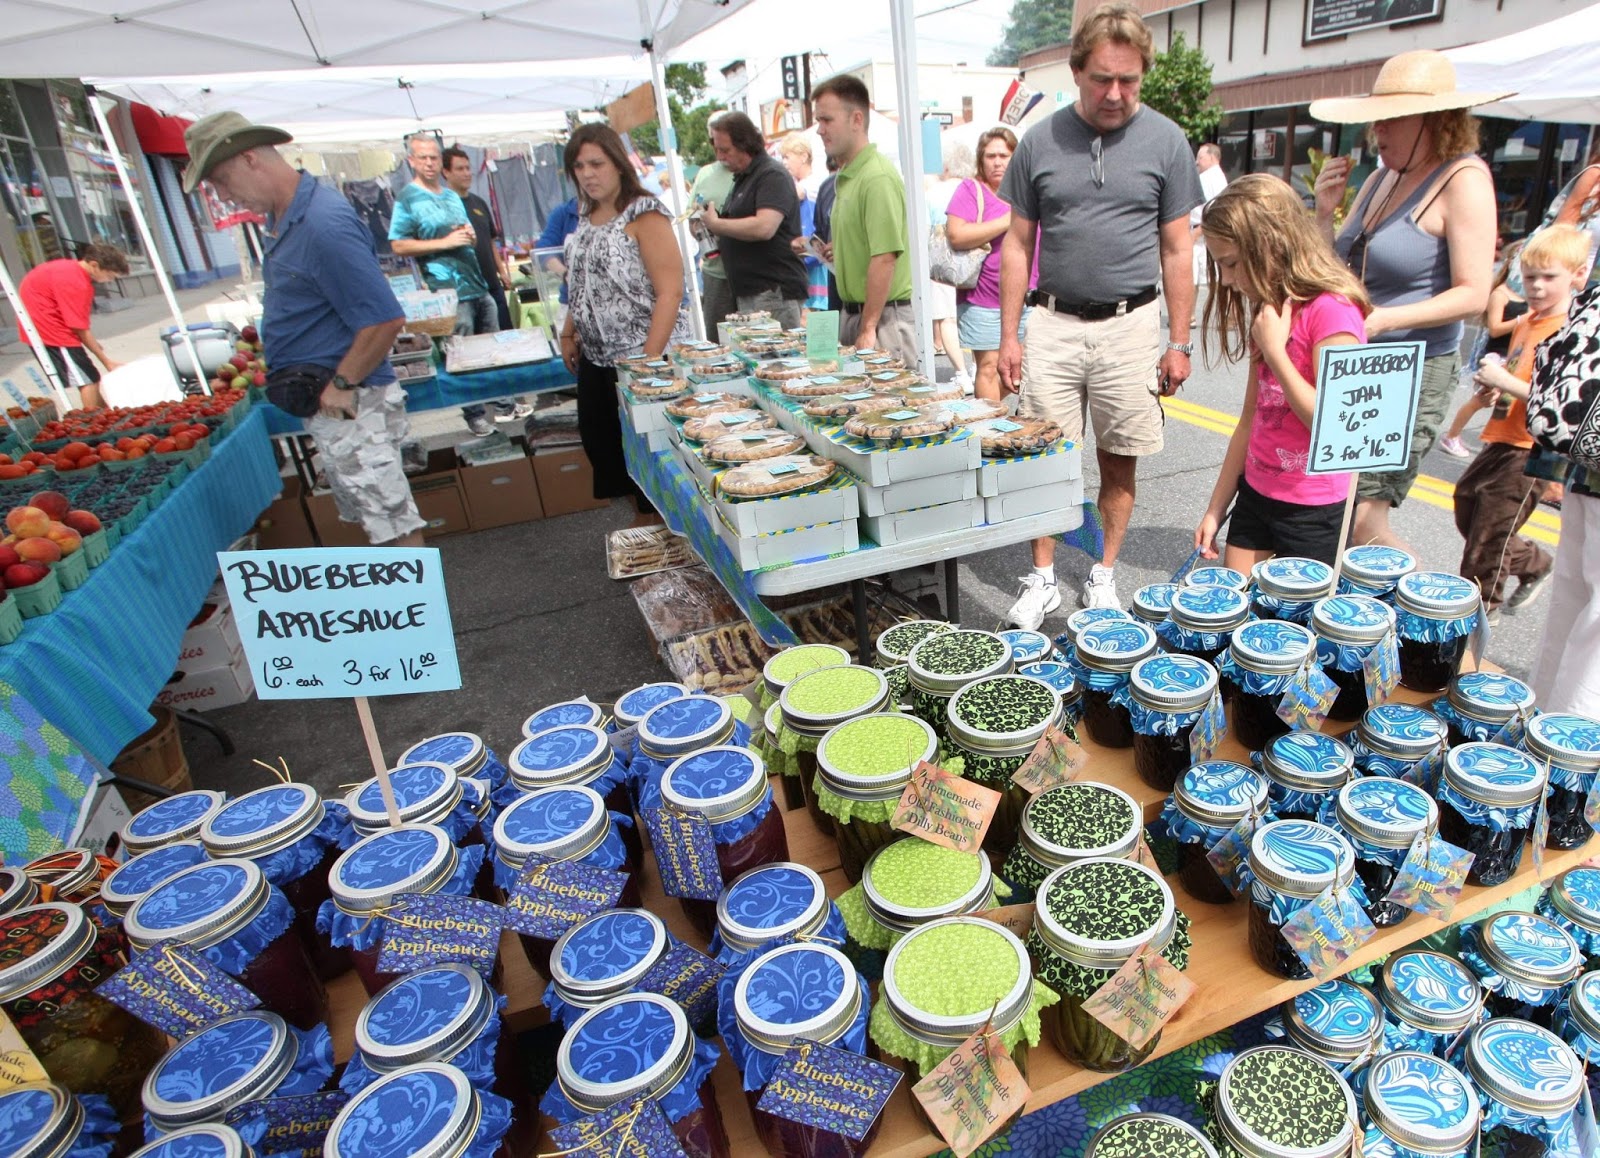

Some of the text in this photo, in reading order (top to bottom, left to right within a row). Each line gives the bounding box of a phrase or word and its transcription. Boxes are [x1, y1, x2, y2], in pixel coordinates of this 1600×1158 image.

[1330, 353, 1416, 380] BLUEBERRY
[1341, 384, 1382, 406] JAM
[1320, 445, 1334, 462] 3
[1340, 445, 1365, 461] for
[227, 559, 424, 602] BLUEBERRY
[257, 603, 426, 642] APPLESAUCE
[296, 675, 324, 687] each
[343, 660, 362, 685] 3
[369, 665, 391, 682] for
[1294, 698, 1311, 717] Jam
[921, 777, 983, 811] Homemade
[908, 812, 968, 844] Dilly Beans
[928, 801, 983, 831] Fashioned
[660, 811, 689, 892] Applesauce
[680, 822, 706, 891] Blueberry
[530, 873, 611, 904] Blueberry
[1413, 876, 1436, 894] Jam
[402, 915, 492, 938] Blueberry
[510, 895, 587, 923] Applesau
[1319, 897, 1355, 949] Blueberry
[384, 938, 490, 960] Applesauce
[1308, 924, 1329, 949] Jam
[153, 958, 233, 1016] Blueberry
[663, 961, 706, 996] eberry
[678, 972, 724, 1009] lesauce
[119, 971, 208, 1027] Applesauc
[1105, 993, 1148, 1029] Dilly Beans
[1114, 976, 1168, 1020] Old Fashioned
[792, 1060, 879, 1099] Blueberry
[949, 1053, 999, 1125] Old Fashioned
[971, 1043, 1010, 1102] Homemade
[768, 1079, 869, 1120] Applesauce
[936, 1074, 975, 1131] Dilly Beans
[267, 1119, 335, 1137] eberr
